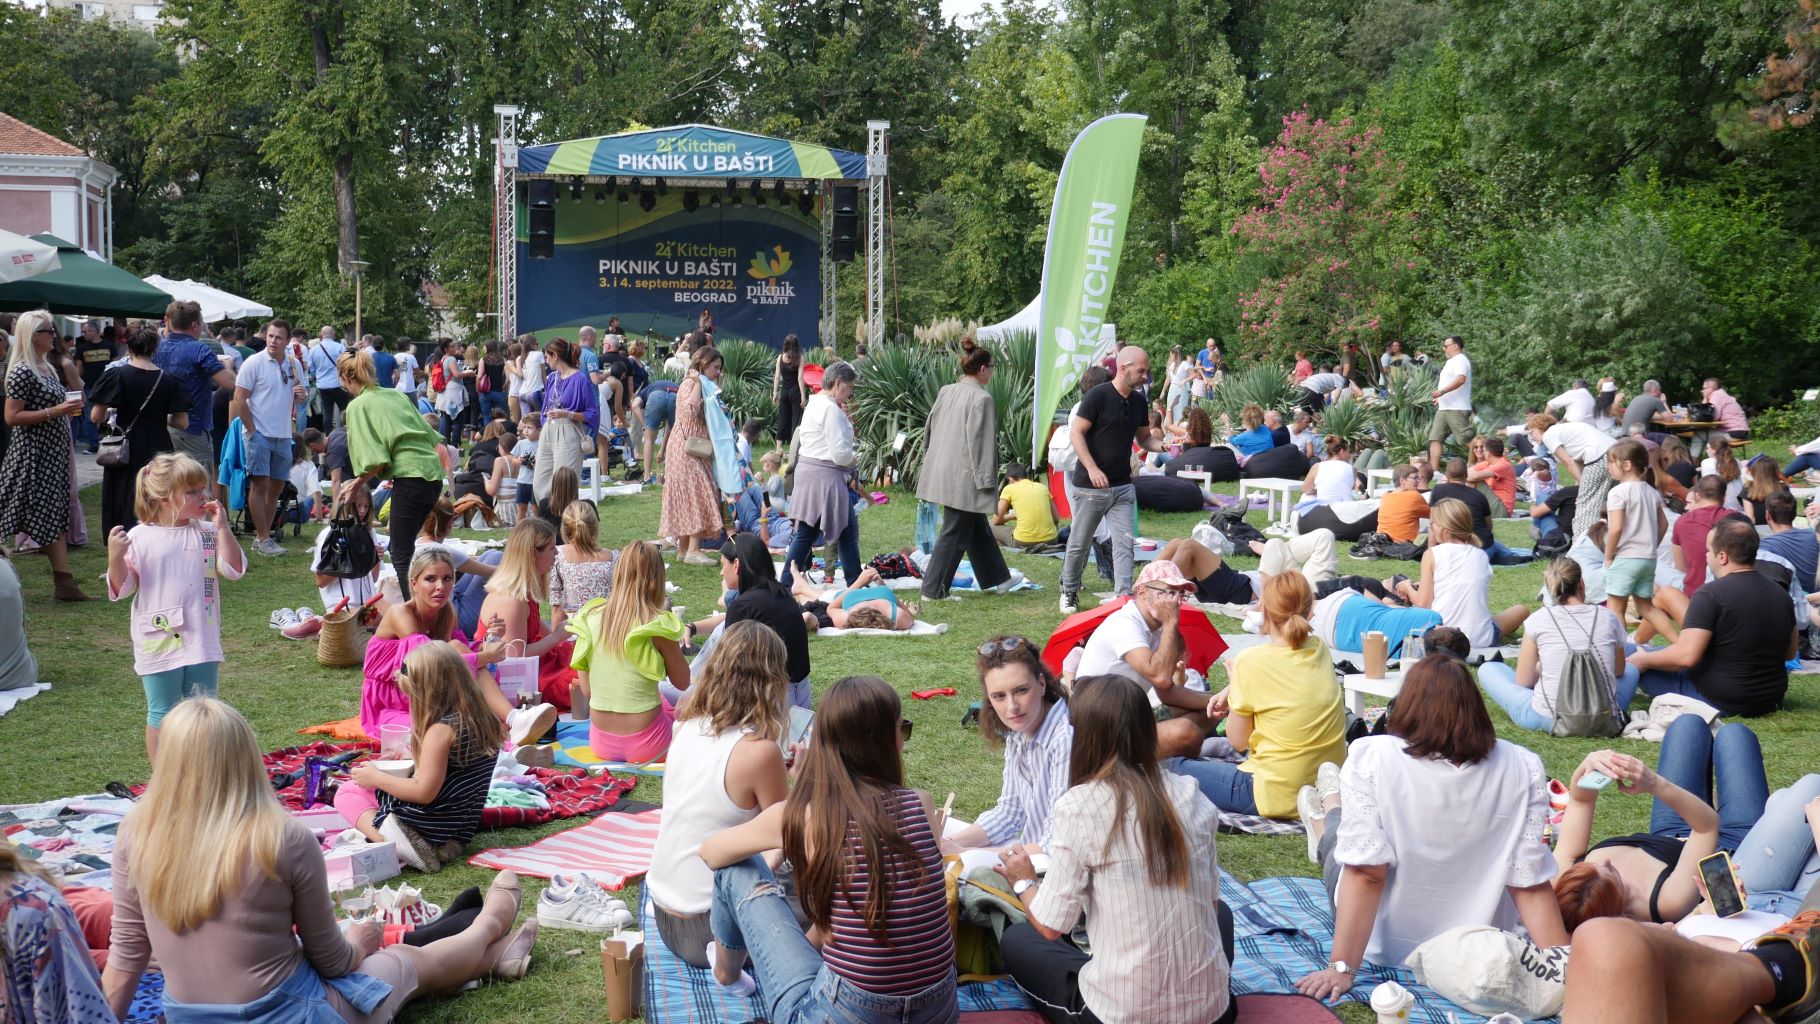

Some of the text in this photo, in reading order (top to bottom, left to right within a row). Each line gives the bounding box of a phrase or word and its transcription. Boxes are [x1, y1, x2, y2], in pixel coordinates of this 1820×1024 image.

[677, 138, 736, 153] Kitchen
[618, 152, 774, 172] PIKNIK U BAŠTI
[677, 243, 737, 258] Kitchen
[599, 258, 737, 276] PIKNIK U BAŠTI
[1078, 201, 1117, 347] KITCHEN
[599, 277, 737, 290] 3. i 4. septembar 2022.
[746, 281, 796, 299] piknik
[674, 292, 737, 303] BEOGRAD
